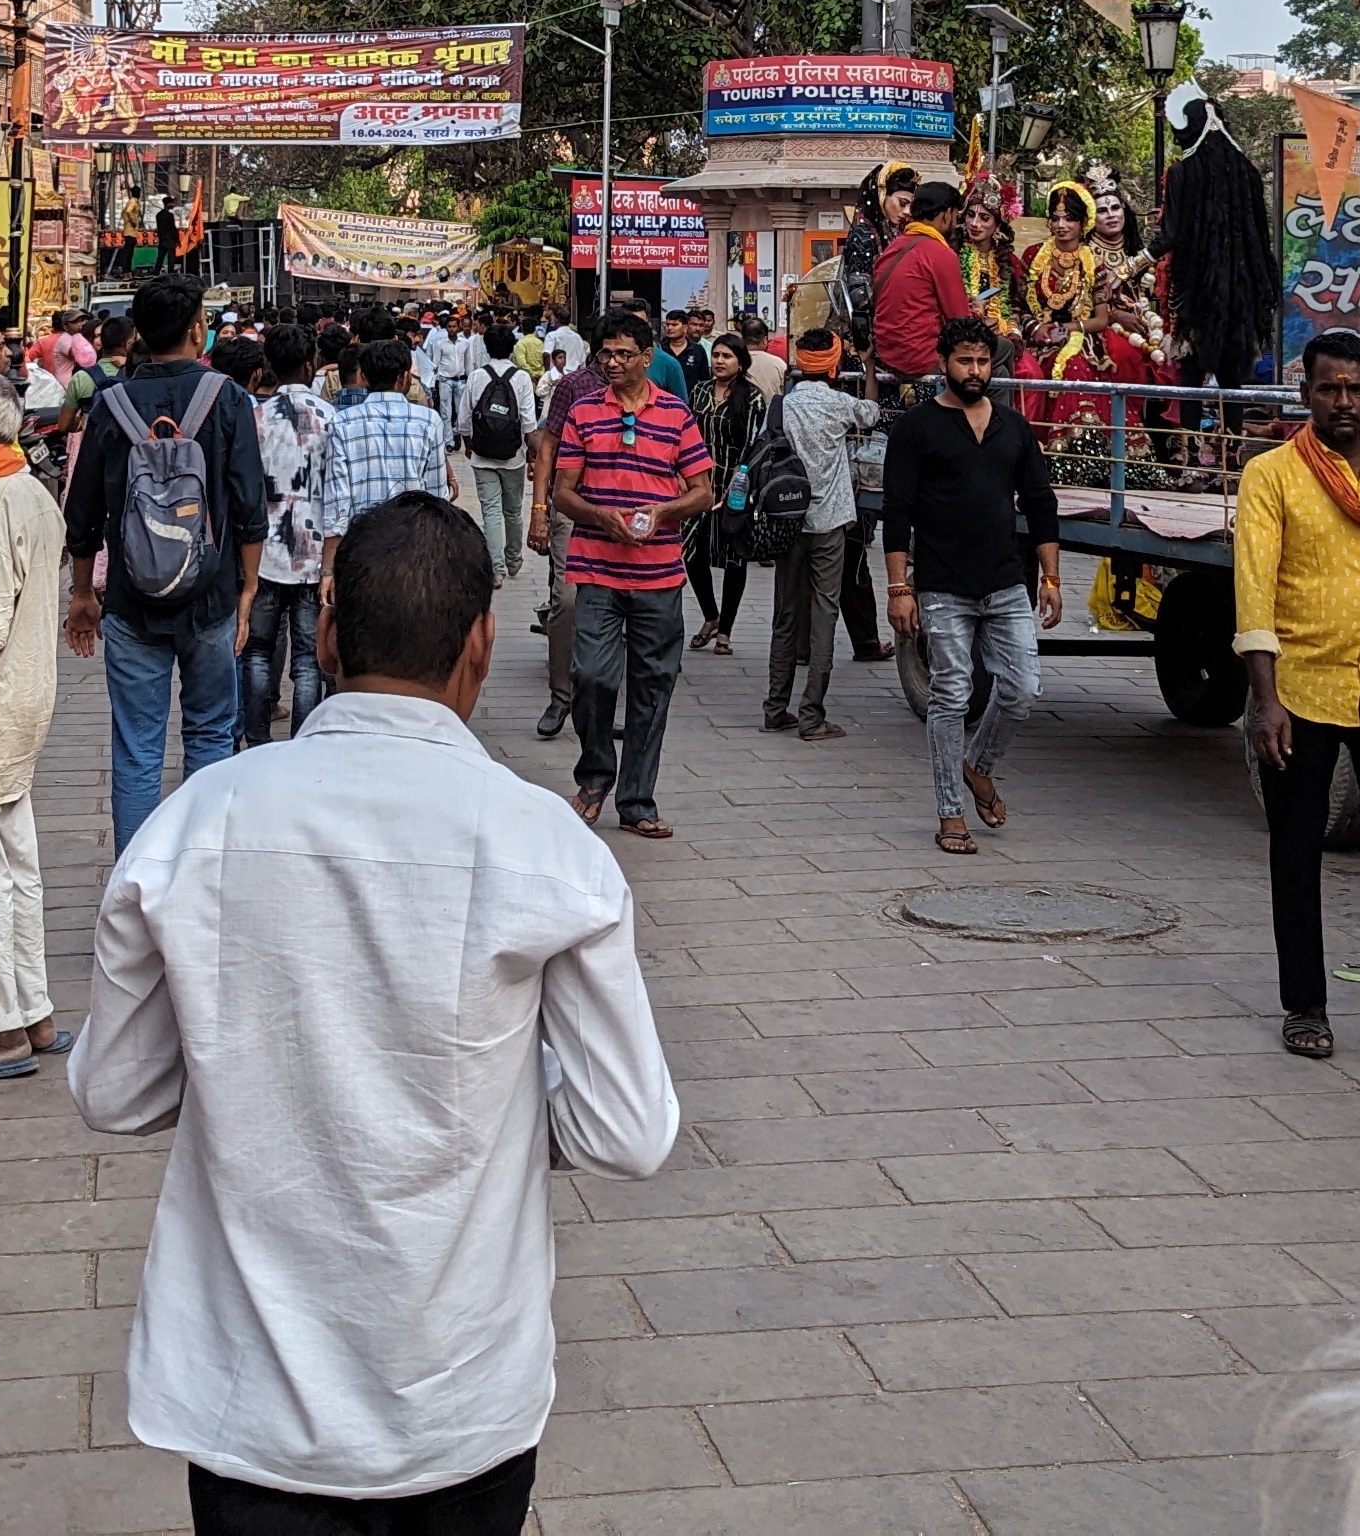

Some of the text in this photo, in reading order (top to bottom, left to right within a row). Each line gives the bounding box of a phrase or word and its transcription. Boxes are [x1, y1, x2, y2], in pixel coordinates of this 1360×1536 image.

[198, 46, 260, 72] दुर्गा
[269, 53, 314, 67] का
[323, 48, 423, 68] वार्षिक
[157, 68, 214, 87] विशाल
[218, 73, 279, 87] जागरण
[301, 71, 373, 87] मनमोहक
[449, 75, 465, 86] की
[468, 75, 501, 89] प्रस्तुति
[731, 59, 935, 89] पर्यटक पुलिस सहायता केन्द्र
[721, 86, 944, 104] TOURIST POLICE HELP DESK
[354, 105, 411, 127] अटूट
[421, 105, 504, 121] भण्डारा
[793, 112, 842, 122] प्रसाद
[847, 112, 907, 123] प्रकाशन
[351, 129, 417, 139] 18.04.2024,
[423, 126, 451, 139] सायं
[454, 130, 460, 138] 7
[464, 127, 487, 138] बजे
[577, 214, 705, 229] TOUIST HELP DESK
[643, 245, 676, 258] प्रकाशन
[681, 240, 708, 265] रुपेश पंचांग
[779, 490, 803, 502] Safari
